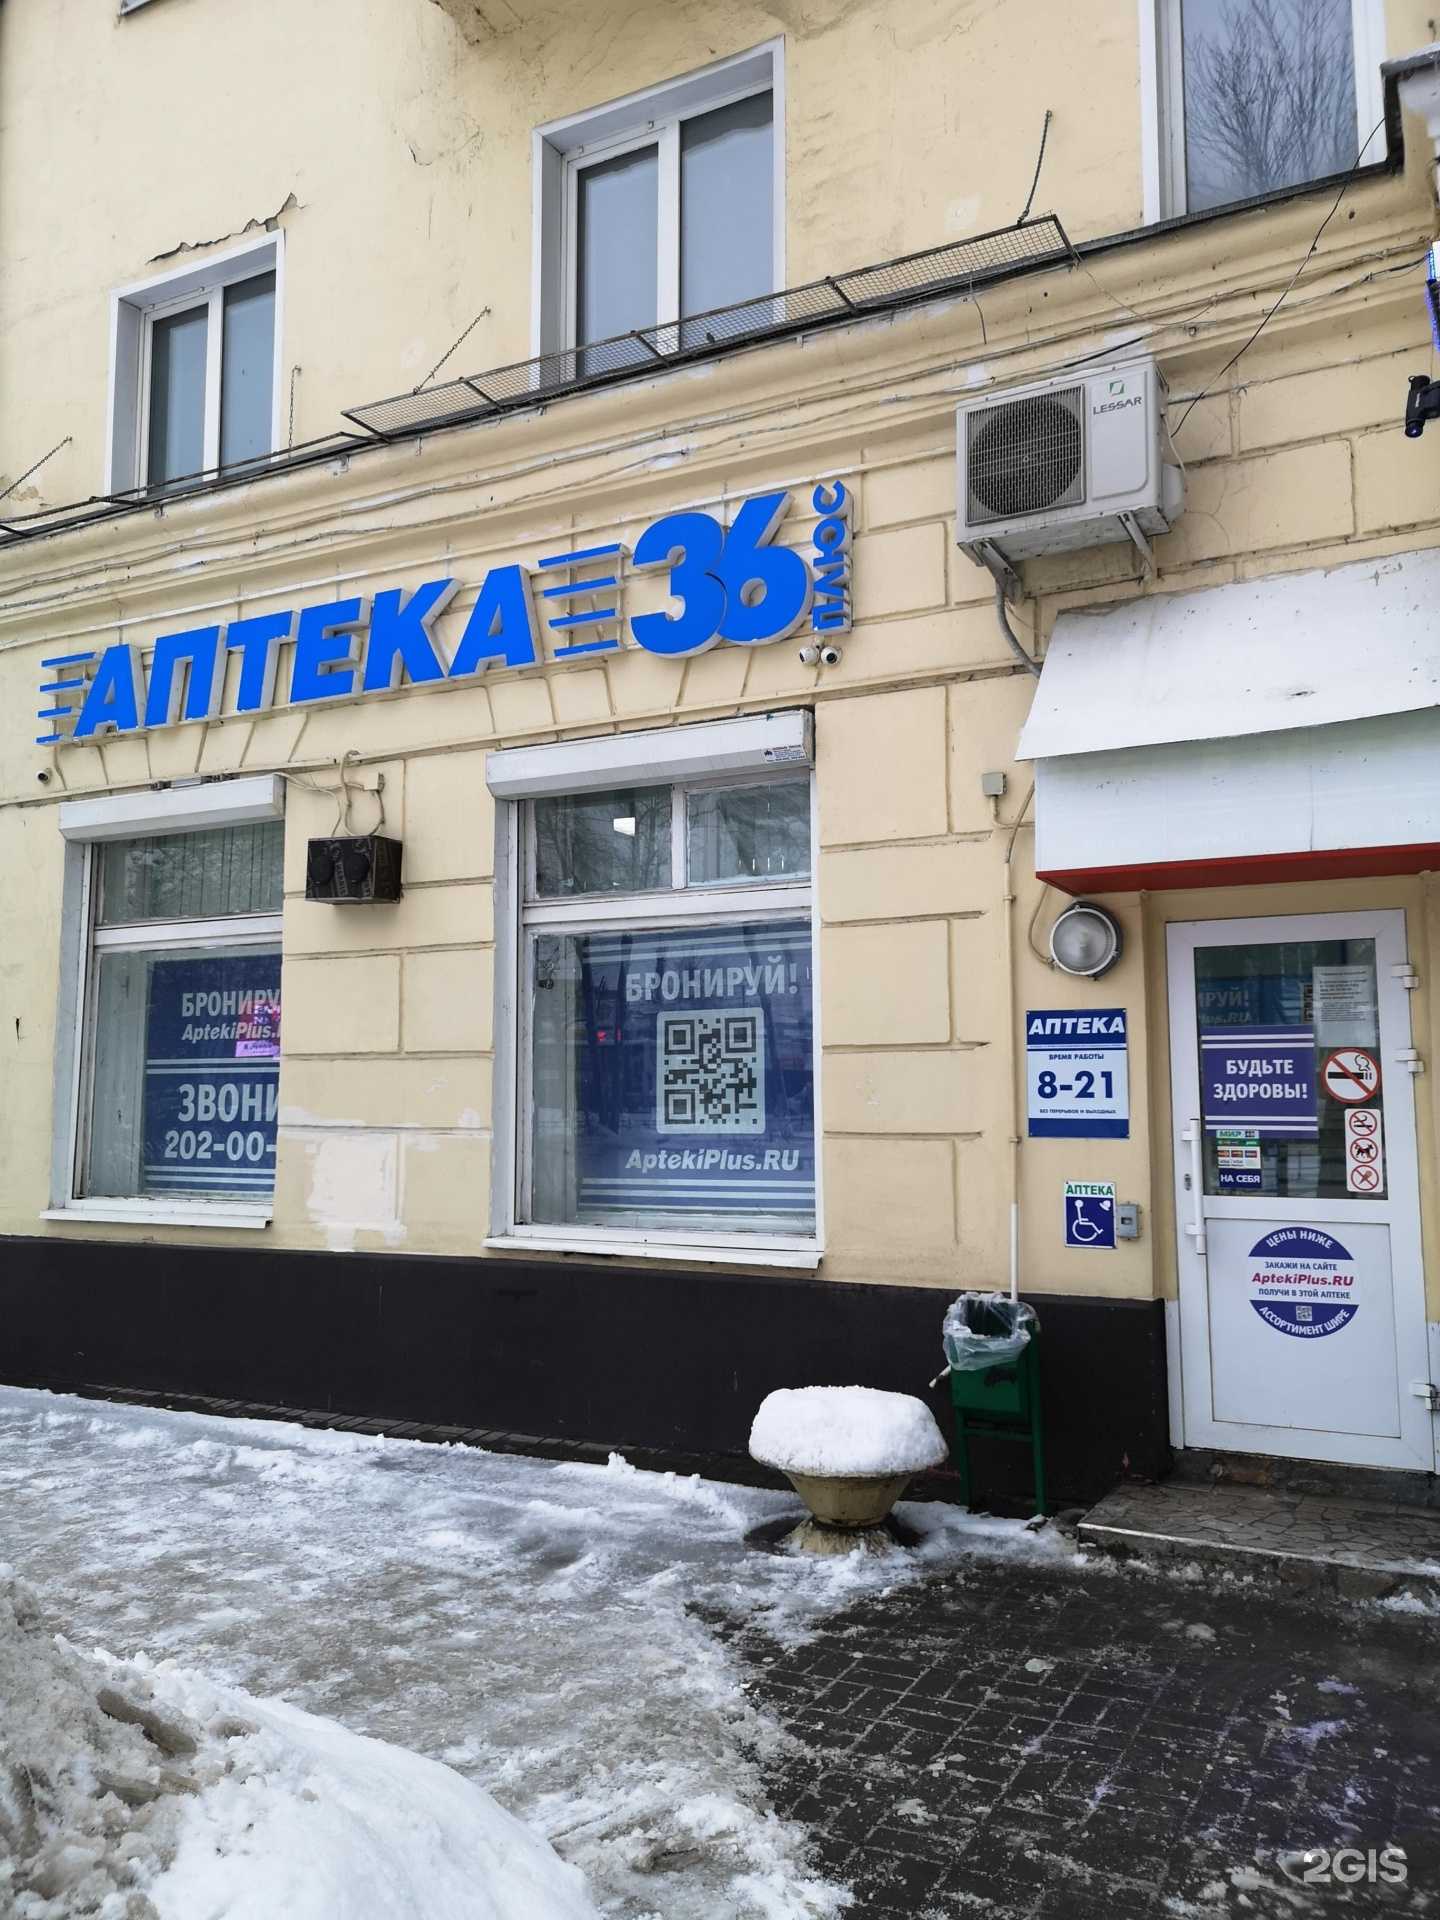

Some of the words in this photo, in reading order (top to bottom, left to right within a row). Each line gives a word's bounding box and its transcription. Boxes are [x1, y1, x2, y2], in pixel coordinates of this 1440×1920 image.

[1093, 397, 1142, 415] LESSAR
[812, 480, 850, 633] ПЛЮС
[73, 564, 541, 738] АПТЕКА
[630, 490, 811, 657] 36
[625, 955, 798, 1002] БРОНИРУЙ!
[181, 1021, 280, 1044] AptekiPlus.
[1028, 1017, 1125, 1035] АПТЕКА
[1226, 1059, 1294, 1077] БУДЬТЕ
[1038, 1071, 1113, 1099] 8-21
[1213, 1083, 1308, 1101] ЗДОРОВЫ!
[625, 1149, 799, 1173] AptekiPlus.RU
[1220, 1174, 1234, 1183] НА
[1236, 1174, 1260, 1183] СЕБЯ
[1066, 1184, 1114, 1195] АПТЕКА
[1266, 1230, 1296, 1247] ЦЕНЫ
[1300, 1230, 1333, 1249] НИЖЕ
[1264, 1261, 1298, 1270] ЗАКАЖИ
[1312, 1262, 1338, 1271] САЙТЕ
[1252, 1272, 1354, 1286] AptekiPlus.RU
[1258, 1288, 1290, 1297] ПОЛУЧИ
[1292, 1289, 1297, 1297] В
[1298, 1289, 1319, 1298] ЭТОЙ
[1320, 1290, 1351, 1299] АПТЕКЕ
[1259, 1306, 1324, 1335] АССОРТИМЕНТ
[1323, 1308, 1350, 1331] ШИРЕ
